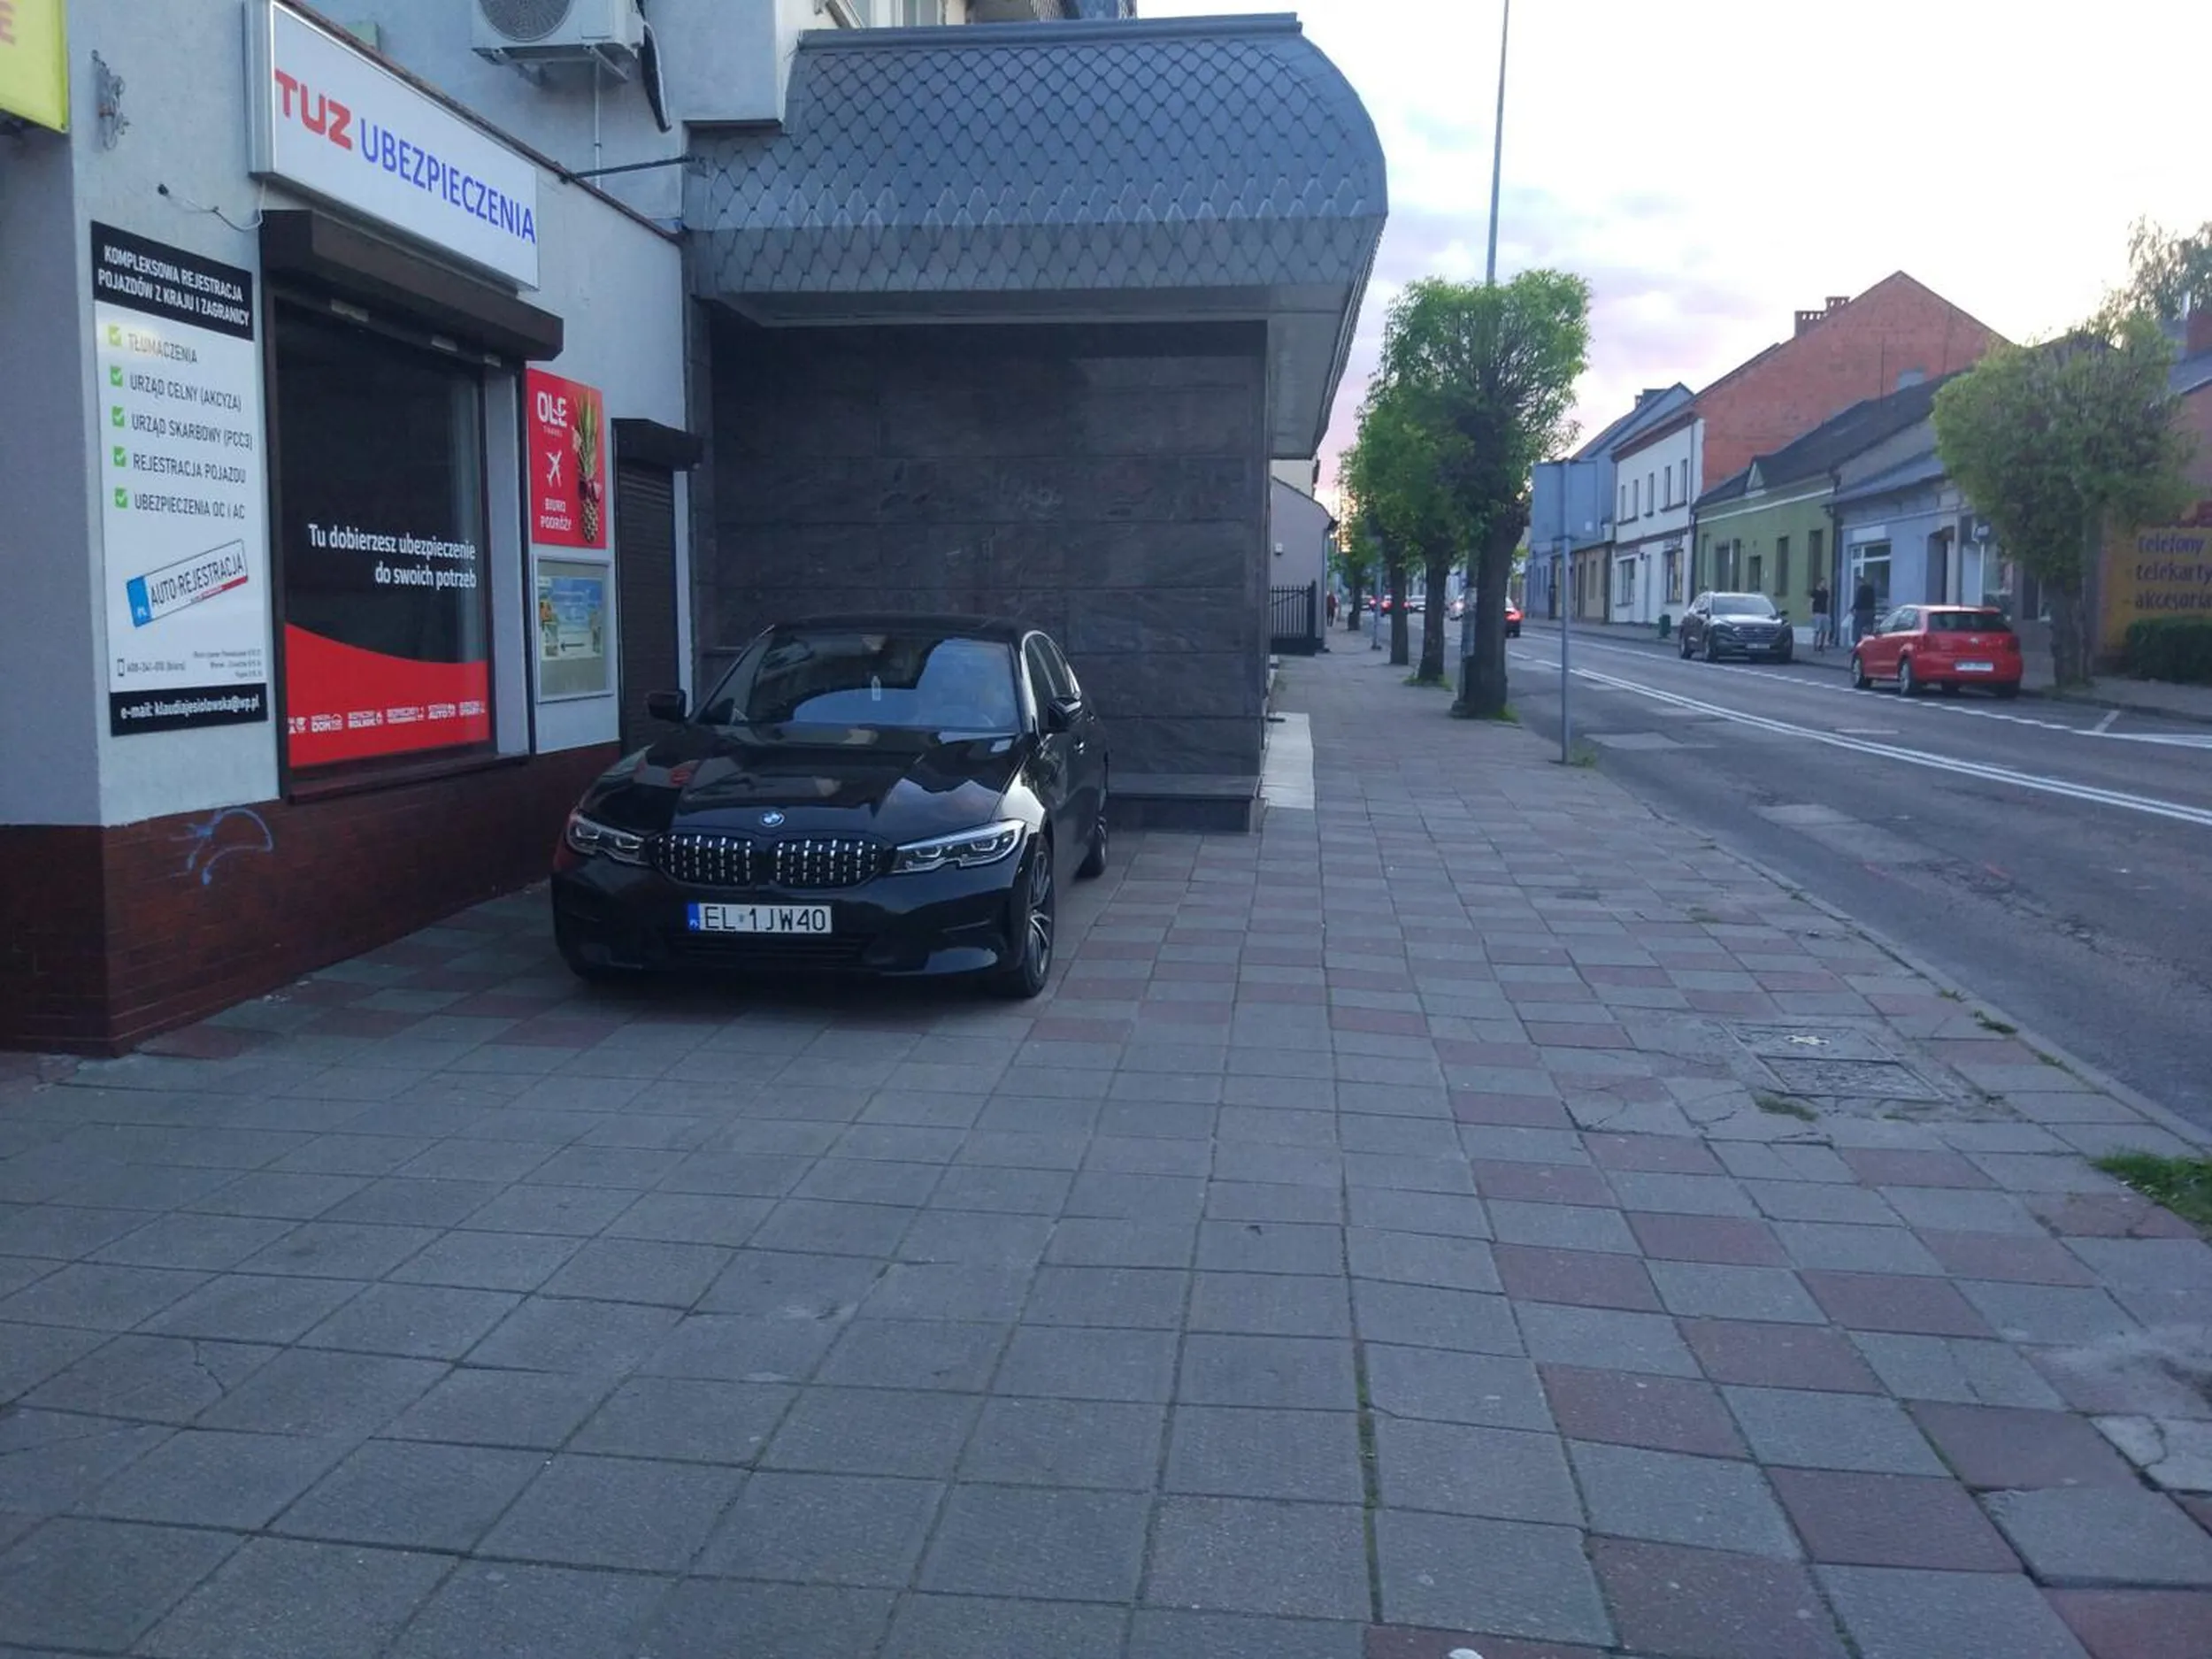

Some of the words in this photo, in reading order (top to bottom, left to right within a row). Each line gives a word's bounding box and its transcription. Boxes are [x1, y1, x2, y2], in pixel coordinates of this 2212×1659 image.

[274, 72, 353, 151] TUZ
[360, 117, 536, 244] UBEZPIECZENIA
[104, 244, 180, 284] KOMPLEKSOWA
[180, 268, 244, 303] REJESTRACJA
[97, 267, 152, 301] POJAZDÓW
[155, 284, 163, 303] Z
[163, 288, 194, 311] KRAJU
[195, 296, 200, 313] I
[201, 297, 250, 327] ZAGRANICY
[128, 333, 197, 363] TŁUMACZENIA
[129, 374, 165, 399] URZĄD
[167, 380, 198, 403] CELNY
[200, 386, 242, 413] (AKCYZA)
[131, 413, 166, 438] URZĄD
[168, 419, 222, 444] SKARBOWY
[133, 453, 203, 479] REJESTRACJA
[204, 462, 247, 484] POJAZDU
[134, 493, 210, 517] UBEZPIECZENIA
[212, 501, 226, 518] OC
[233, 503, 246, 520] AC
[309, 524, 326, 548] Tu
[329, 526, 396, 552] dobierzesz
[399, 534, 476, 561] ubezpieczenie
[150, 578, 177, 607] AUTO
[178, 552, 244, 596] REJESTRACJA
[375, 560, 391, 584] do
[394, 564, 434, 587] swoich
[436, 570, 477, 591] potrzeb
[705, 906, 736, 930] EL
[749, 908, 826, 932] 1JW40
